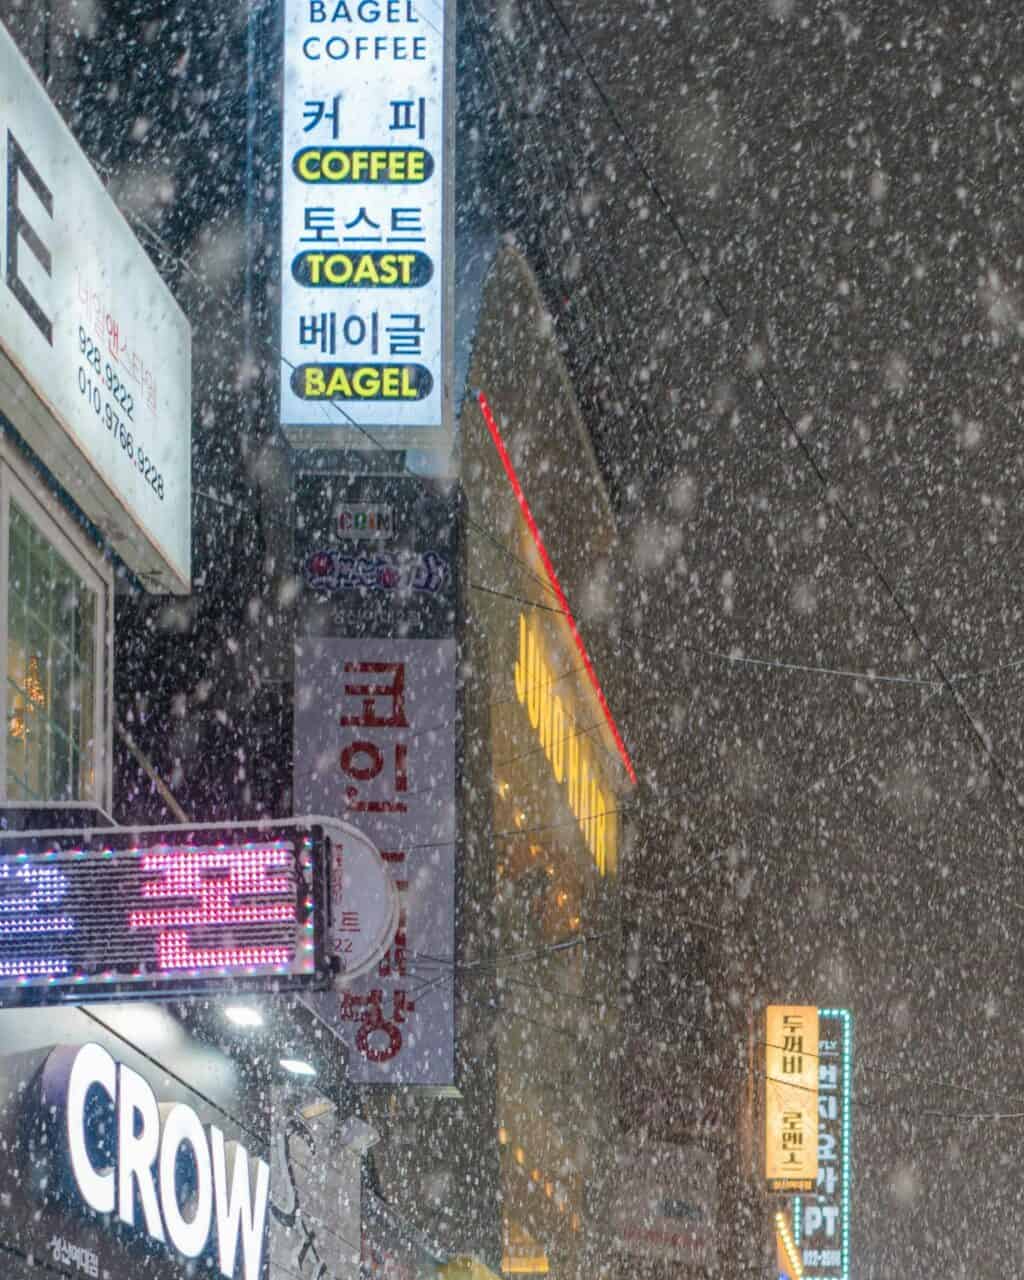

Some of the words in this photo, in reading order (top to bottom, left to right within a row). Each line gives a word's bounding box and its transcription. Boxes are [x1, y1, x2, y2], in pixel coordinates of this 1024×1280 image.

[309, 0, 419, 23] BAGEL
[302, 36, 426, 61] COFFEE
[297, 151, 425, 181] COFFEE
[299, 207, 427, 243] 토스트
[306, 253, 416, 285] TOAST
[299, 311, 426, 356] 베이글
[304, 366, 417, 397] BAGEL
[781, 1014, 804, 1075] 두꺼비
